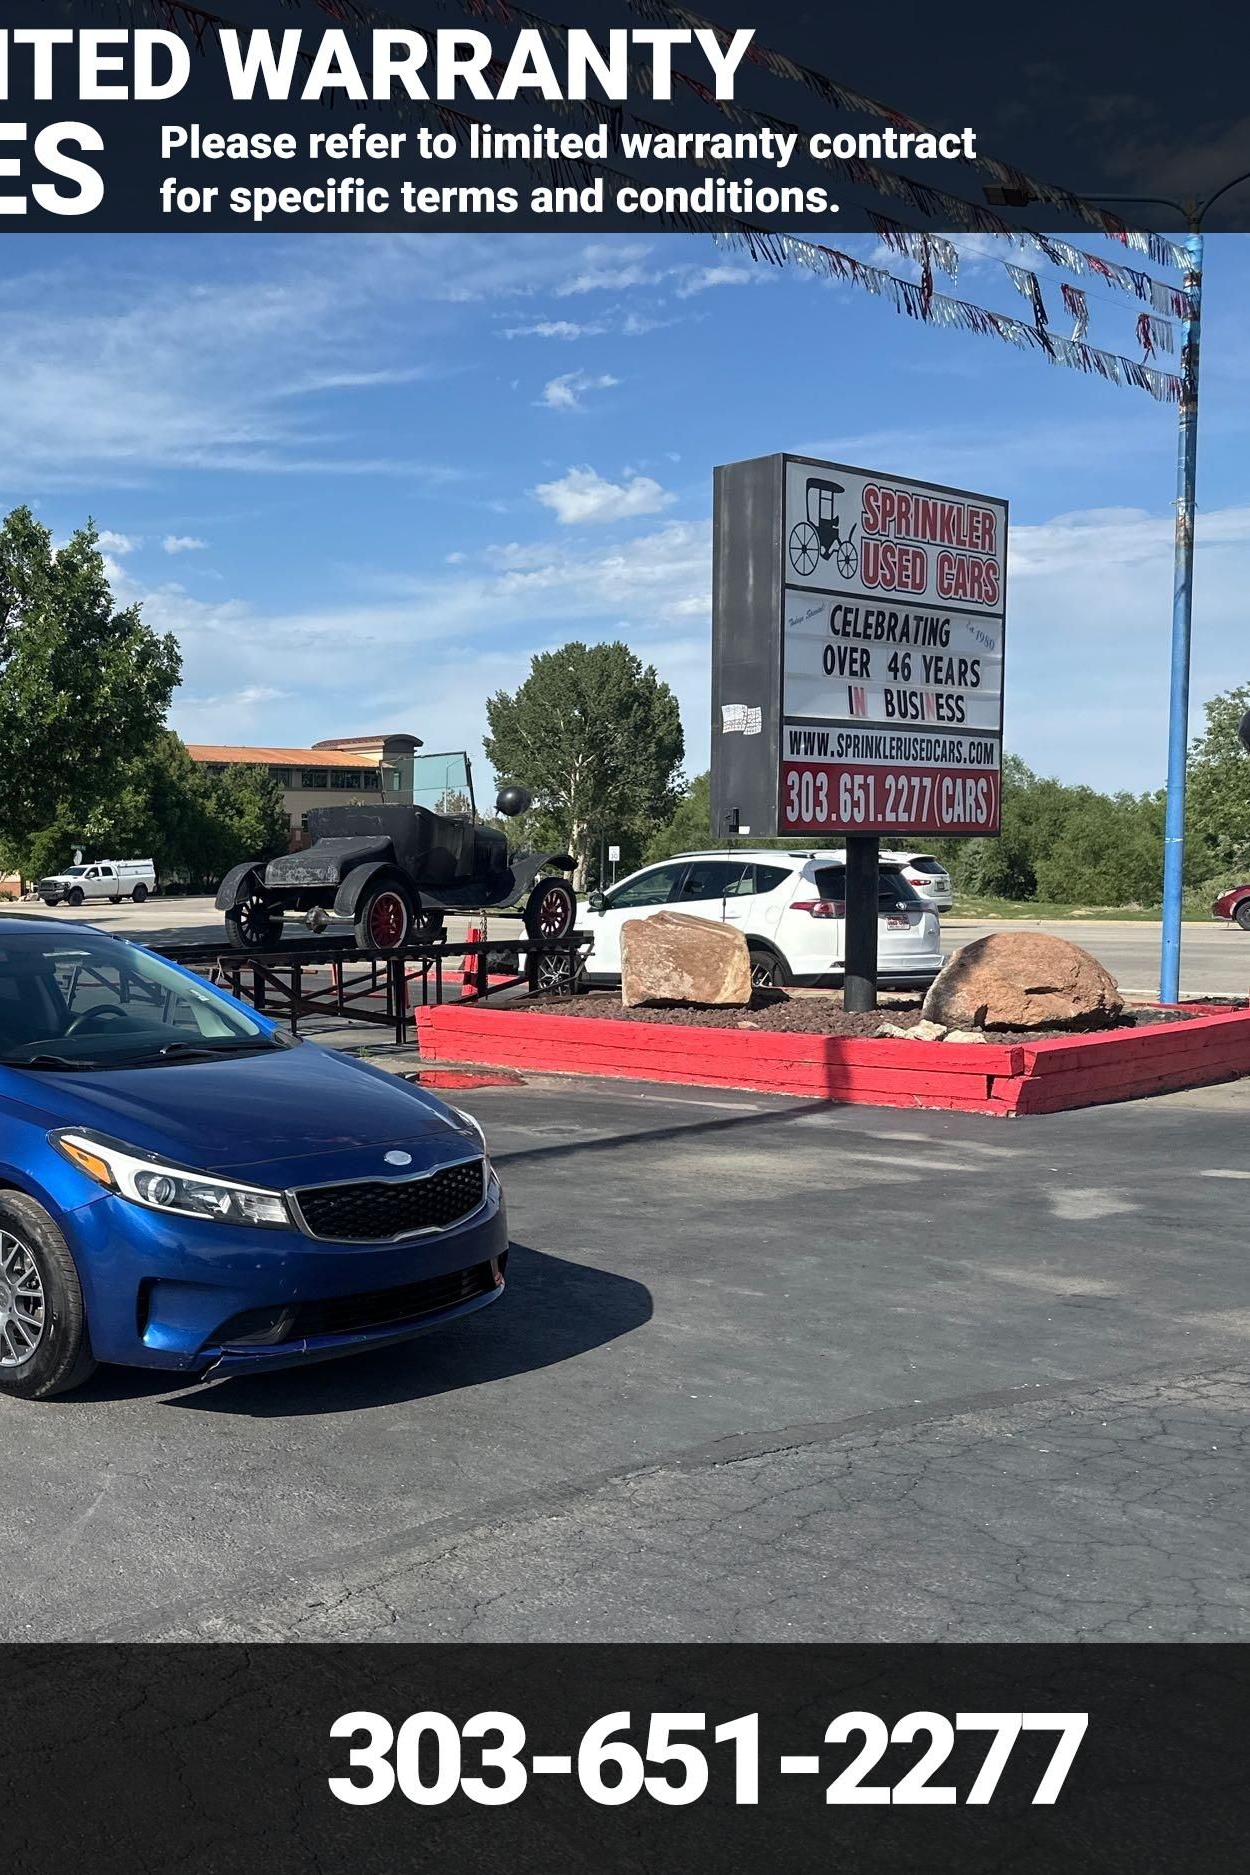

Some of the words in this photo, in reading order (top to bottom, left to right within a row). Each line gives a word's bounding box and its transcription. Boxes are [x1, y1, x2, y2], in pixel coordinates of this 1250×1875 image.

[861, 483, 997, 555] SPRINKLER
[860, 538, 927, 595] USED
[936, 552, 1000, 606] CARS
[830, 604, 950, 648] CELEBRATING
[822, 644, 870, 678] OVER
[887, 651, 912, 681] 46
[922, 655, 981, 688] YEARS
[848, 685, 866, 716] IN
[885, 688, 966, 724] BUSINESS
[788, 730, 994, 765] WWW.SPRINKLERUSEDCARS.COM
